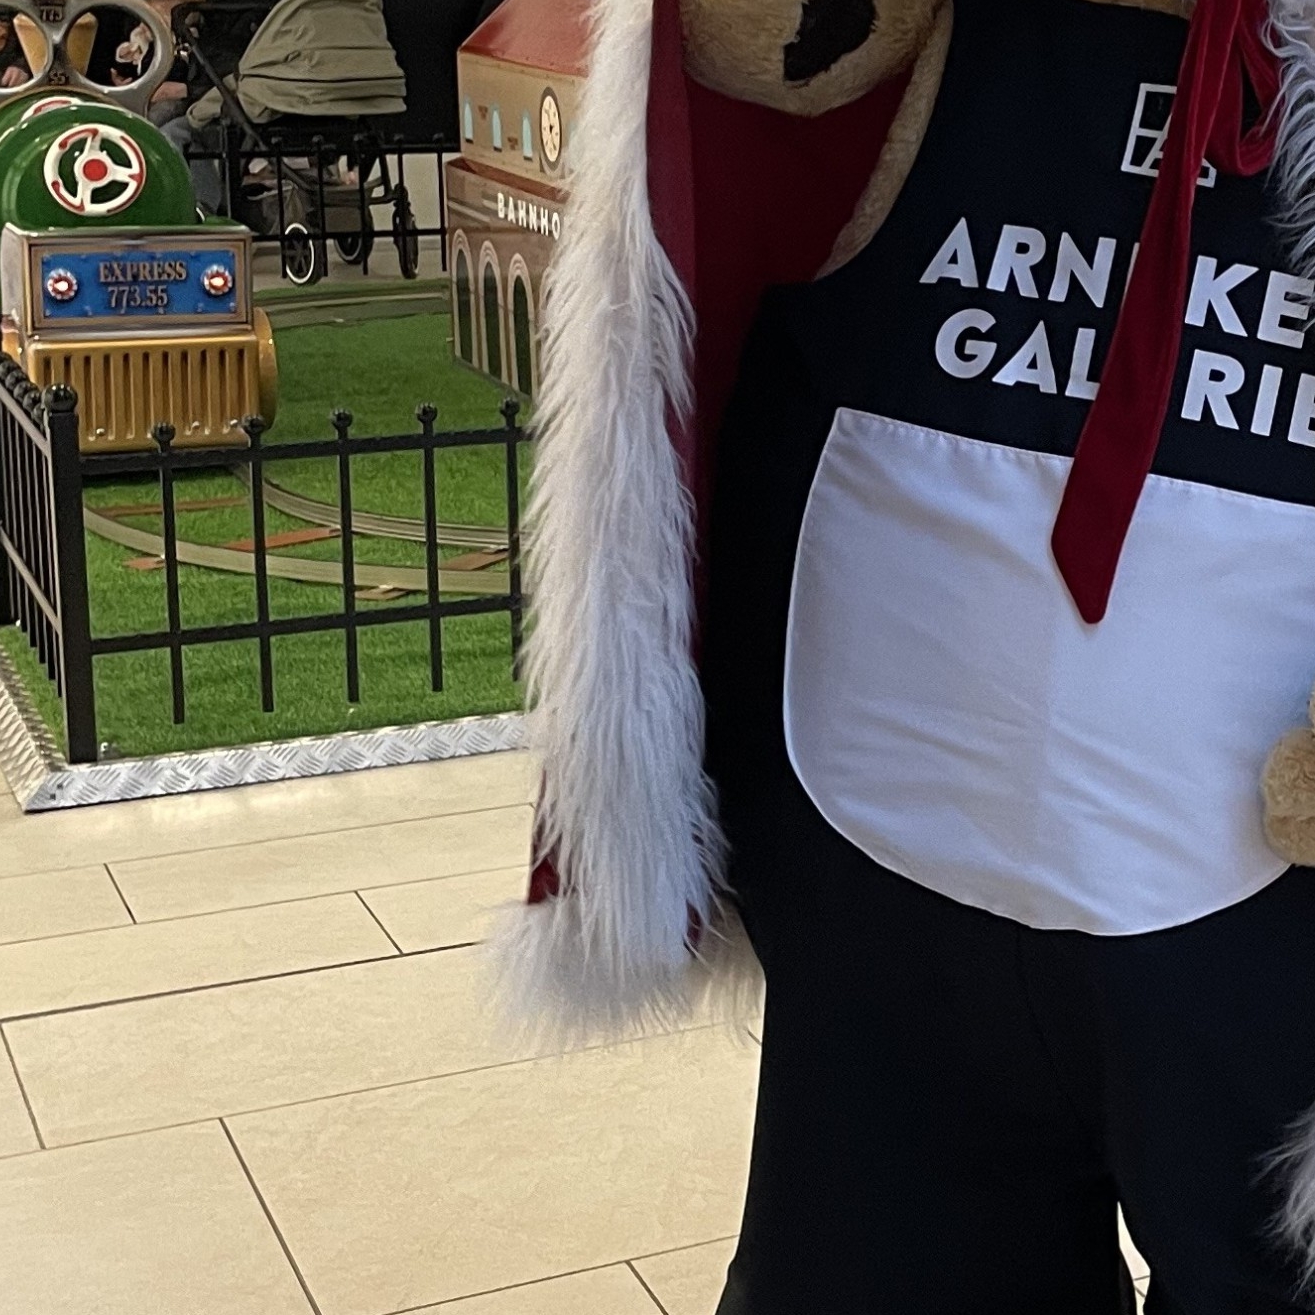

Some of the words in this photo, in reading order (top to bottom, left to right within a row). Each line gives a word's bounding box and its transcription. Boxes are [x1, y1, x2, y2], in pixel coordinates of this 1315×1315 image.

[497, 192, 561, 241] BAHNHO
[100, 261, 187, 282] EXPRESS
[108, 285, 168, 308] 773.55
